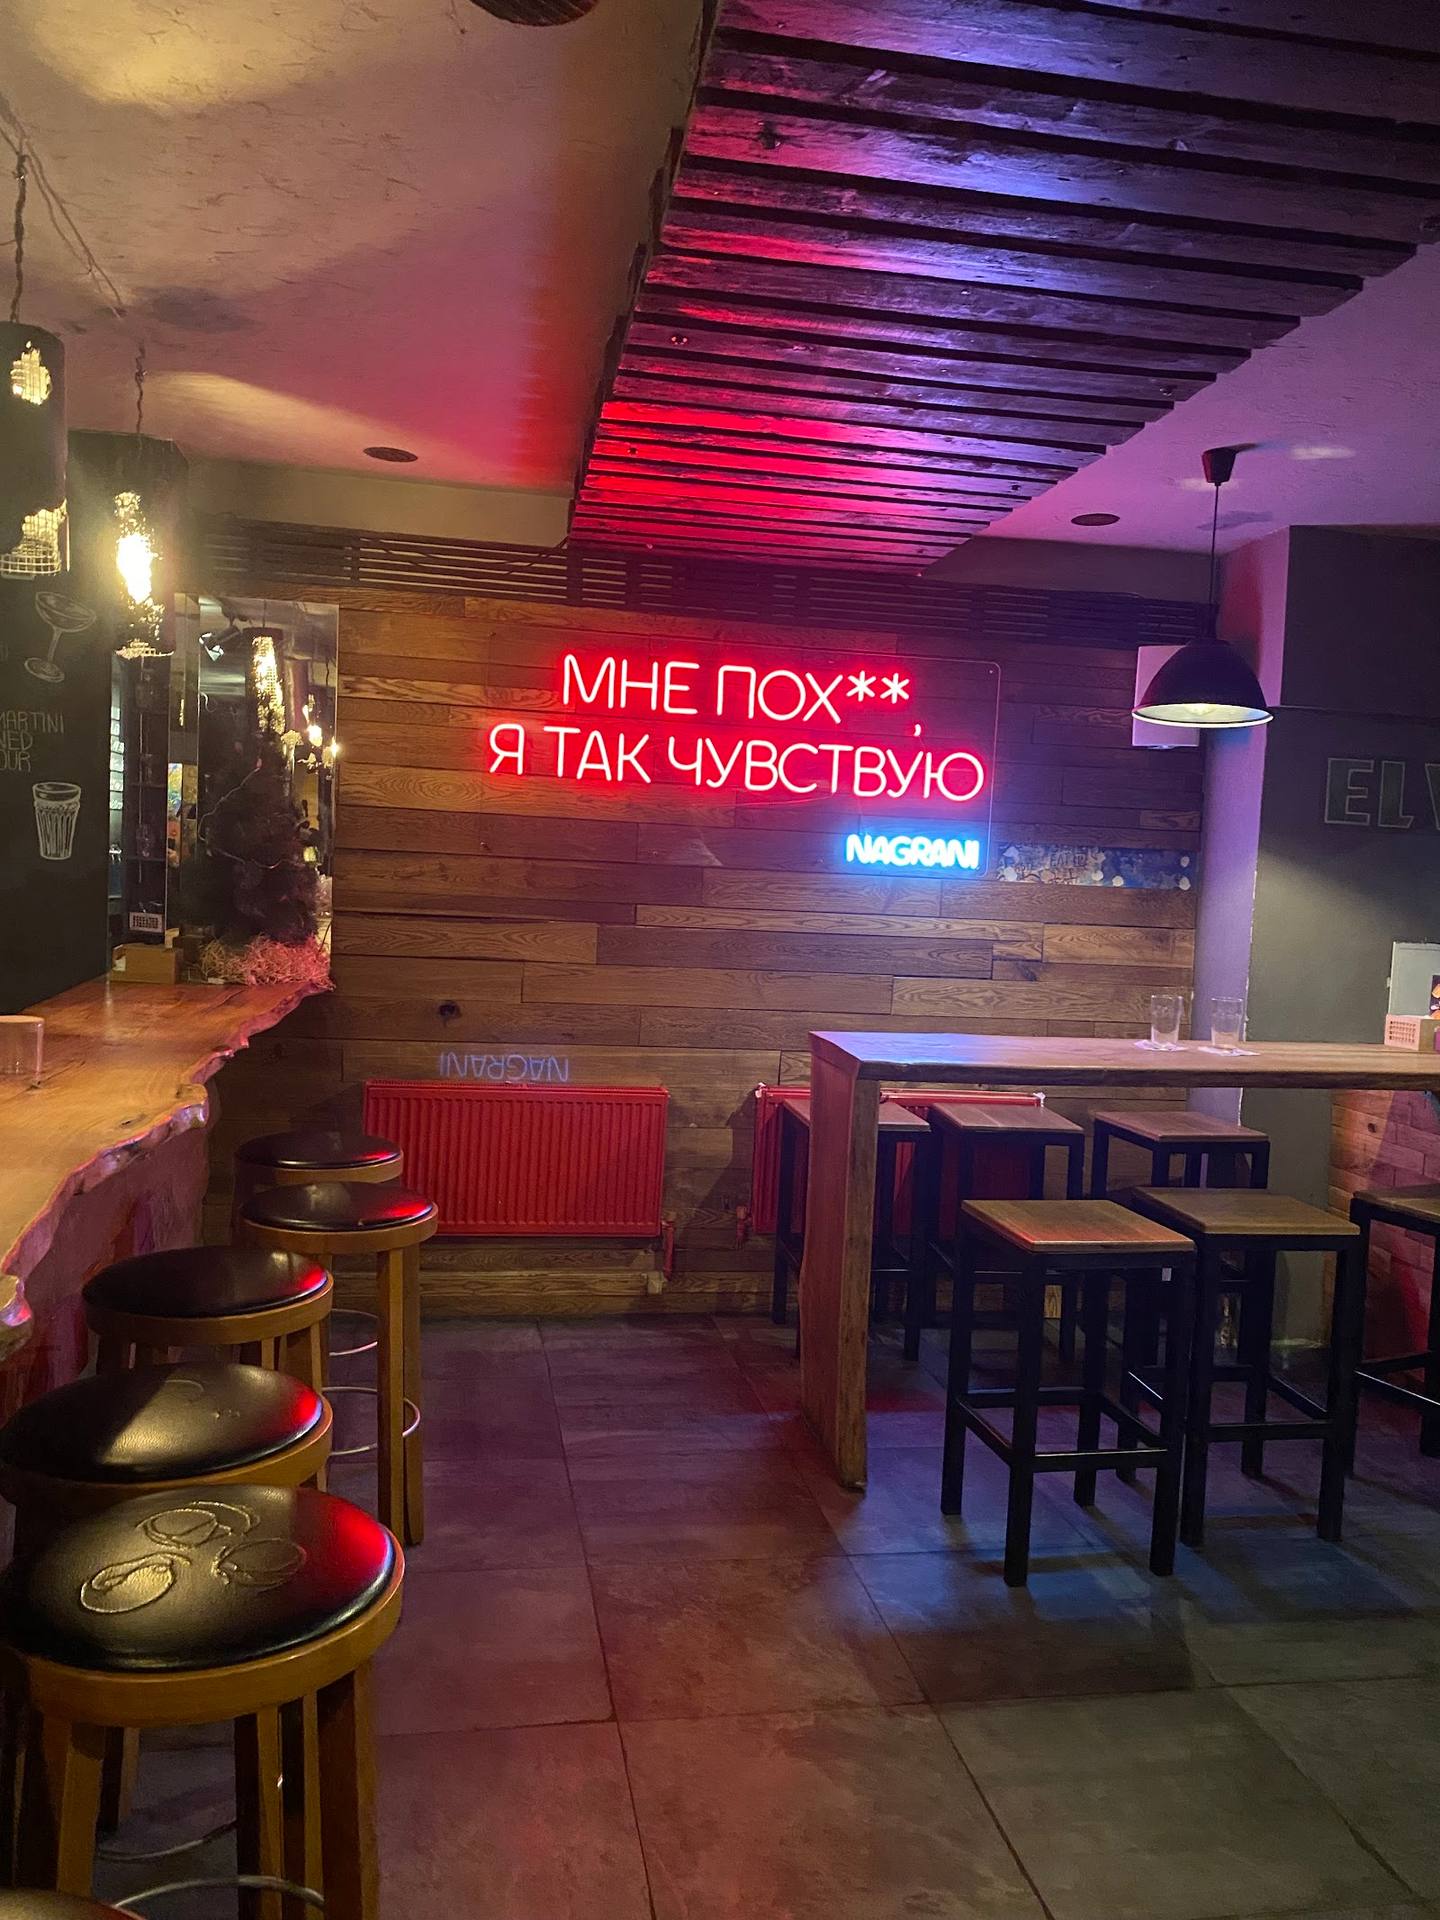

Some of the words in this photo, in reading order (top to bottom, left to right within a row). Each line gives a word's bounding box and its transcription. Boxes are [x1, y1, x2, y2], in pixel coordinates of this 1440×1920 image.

[563, 653, 700, 715] МНЕ
[488, 723, 526, 776] Я
[543, 725, 652, 784] ТАК
[667, 735, 986, 802] ЧУВСТВУЮ
[1325, 757, 1440, 831] EL
[846, 833, 980, 870] NAGRANI
